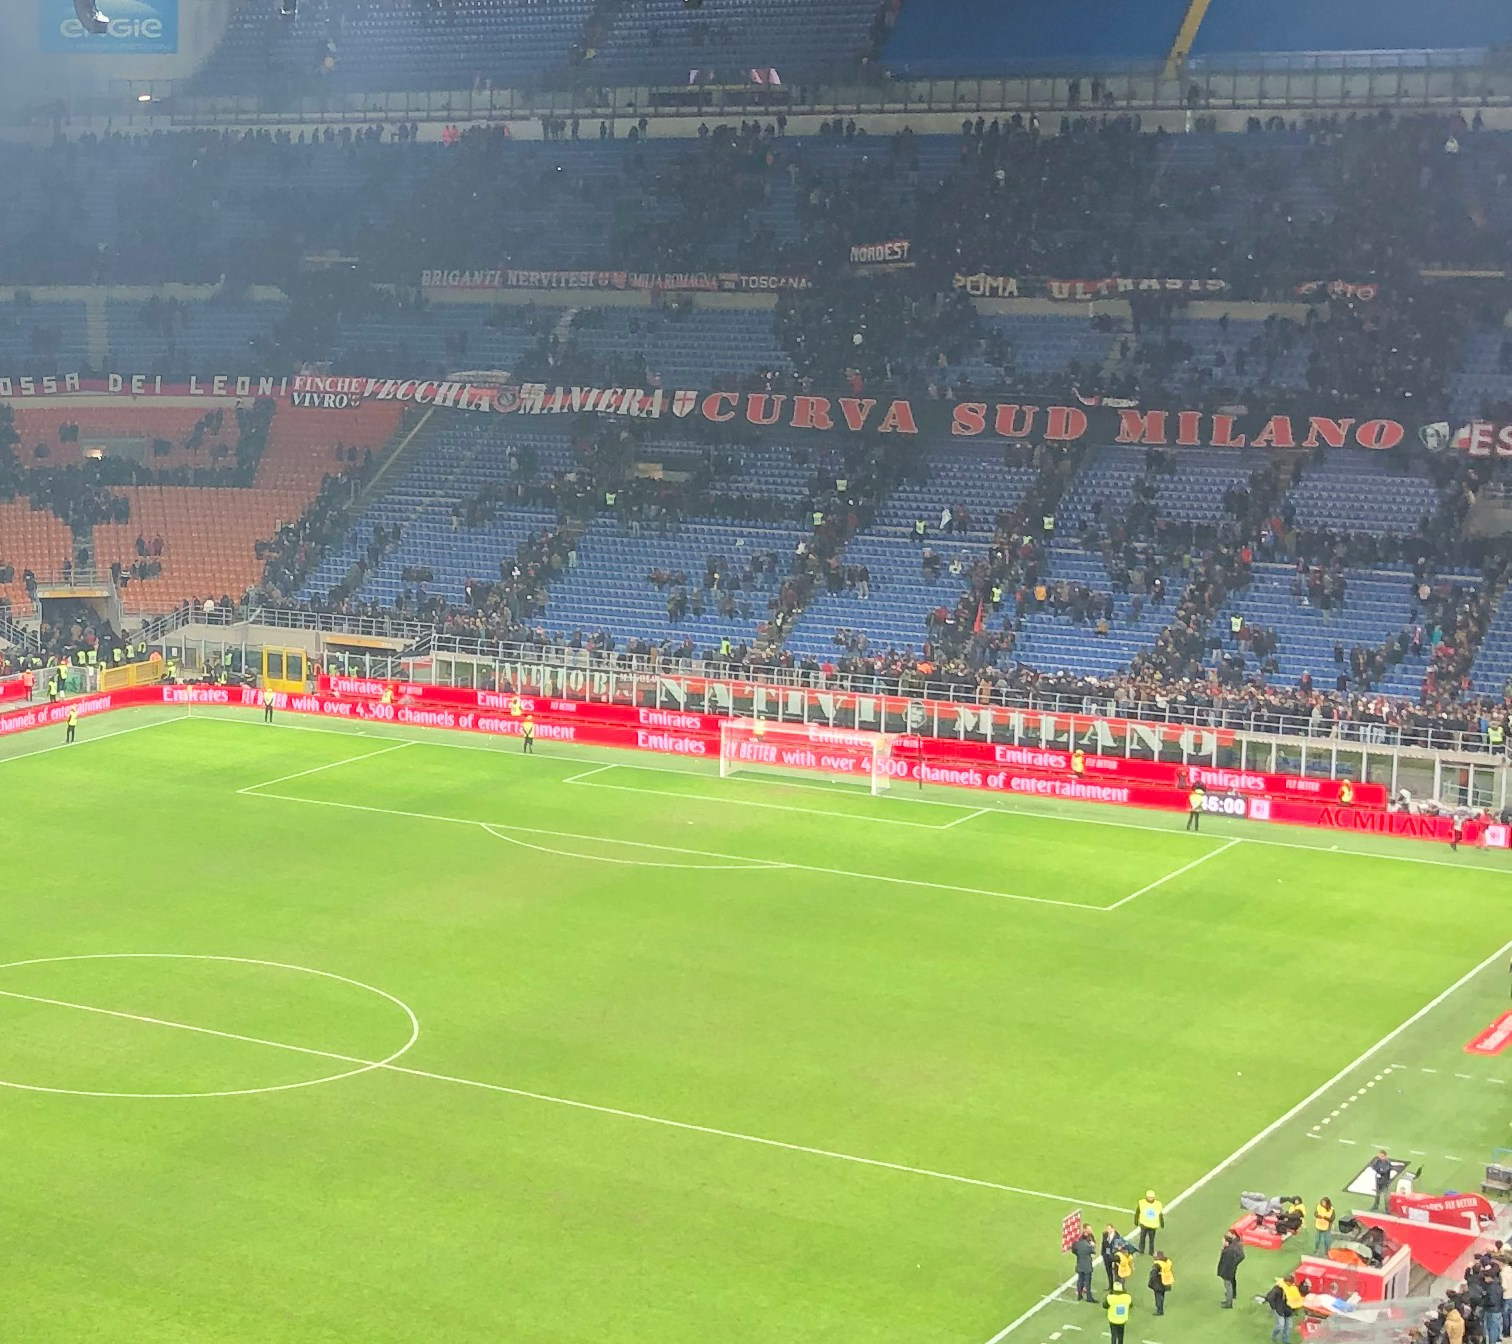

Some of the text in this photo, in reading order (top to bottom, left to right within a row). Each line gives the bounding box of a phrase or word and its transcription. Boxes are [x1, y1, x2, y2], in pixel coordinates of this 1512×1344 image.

[850, 241, 912, 262] NORDEST
[421, 269, 502, 287] BRIGANTI
[108, 374, 162, 394] DEI
[190, 375, 287, 396] LEONI
[363, 377, 663, 419] VECCHIA MANIERA
[701, 392, 1405, 449] CURVA SUD MILANO
[329, 677, 383, 695] Emirates
[38, 706, 49, 723] of
[162, 687, 228, 704] Emirates
[291, 696, 319, 712] with
[323, 702, 353, 714] over
[355, 702, 395, 722] 4,500
[397, 706, 455, 726] channels
[459, 712, 475, 728] of
[639, 709, 701, 730] Emirates
[638, 731, 706, 754] Emirates
[740, 742, 776, 763] BETTER
[781, 748, 815, 767] with
[820, 754, 856, 772] over
[911, 759, 982, 785] channels
[987, 772, 1006, 790] of
[1010, 772, 1129, 802] entertainment
[995, 744, 1066, 769] Emirates
[1189, 766, 1265, 790] Emirates
[1352, 809, 1438, 838] MILAN
